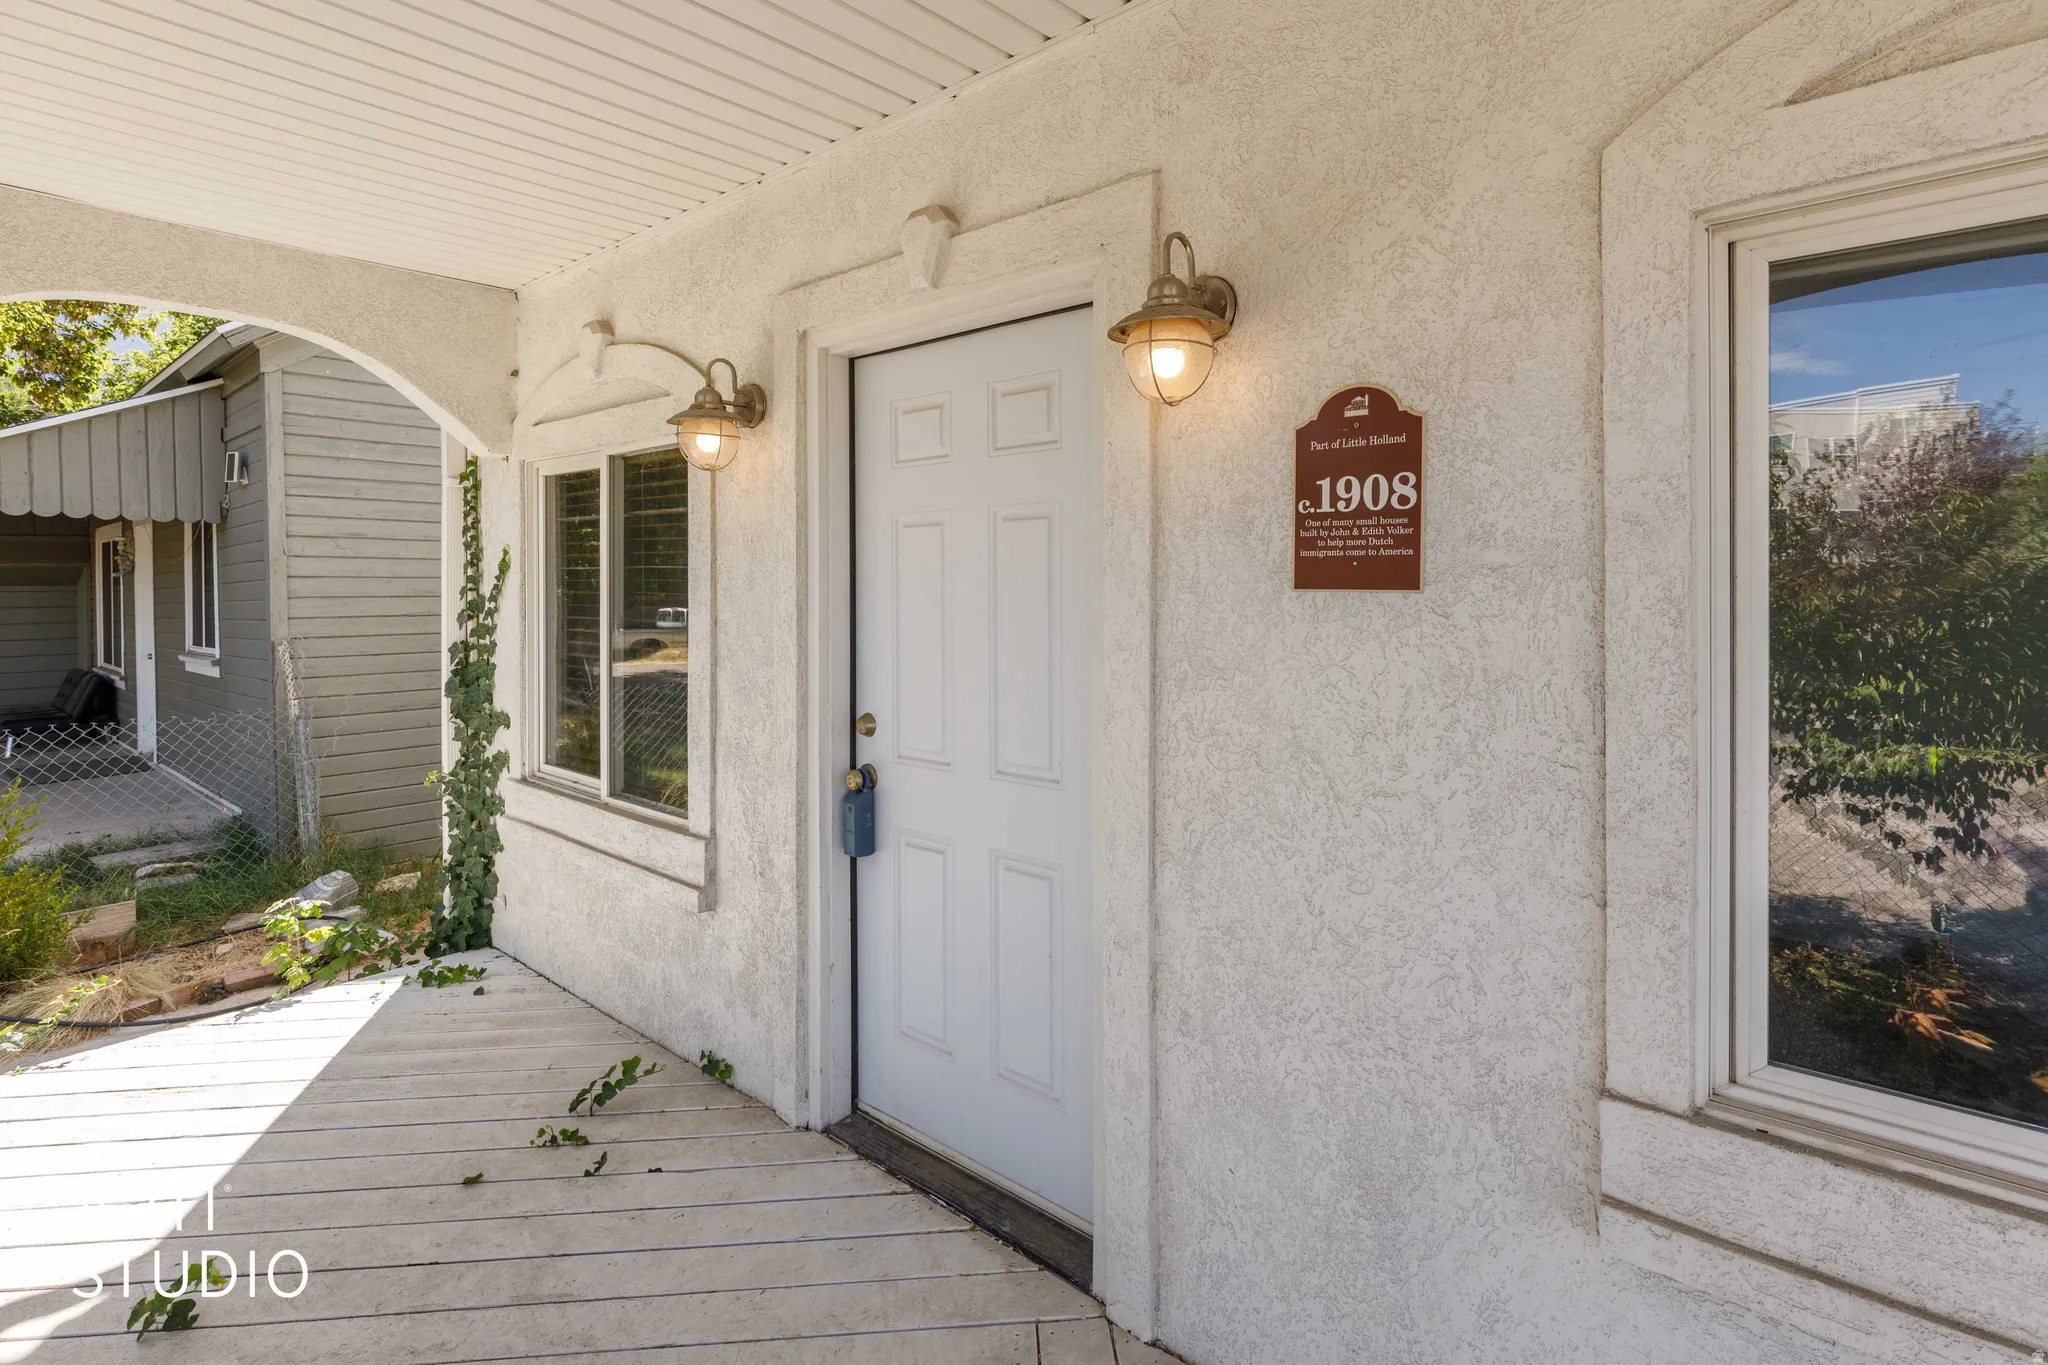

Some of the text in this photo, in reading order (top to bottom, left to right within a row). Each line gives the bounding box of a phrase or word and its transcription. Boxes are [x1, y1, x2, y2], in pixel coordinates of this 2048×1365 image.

[1310, 432, 1406, 451] Part of Little Holland
[1298, 471, 1418, 514] c.1908
[1305, 516, 1408, 528] One of many small houses
[1300, 526, 1414, 538] built by John & Edith Volker
[1317, 539, 1326, 547] to
[1327, 538, 1345, 547] help
[1368, 537, 1394, 545] Dutch
[1300, 549, 1344, 558] immigrants
[1368, 548, 1377, 556] to
[1378, 547, 1414, 556] America
